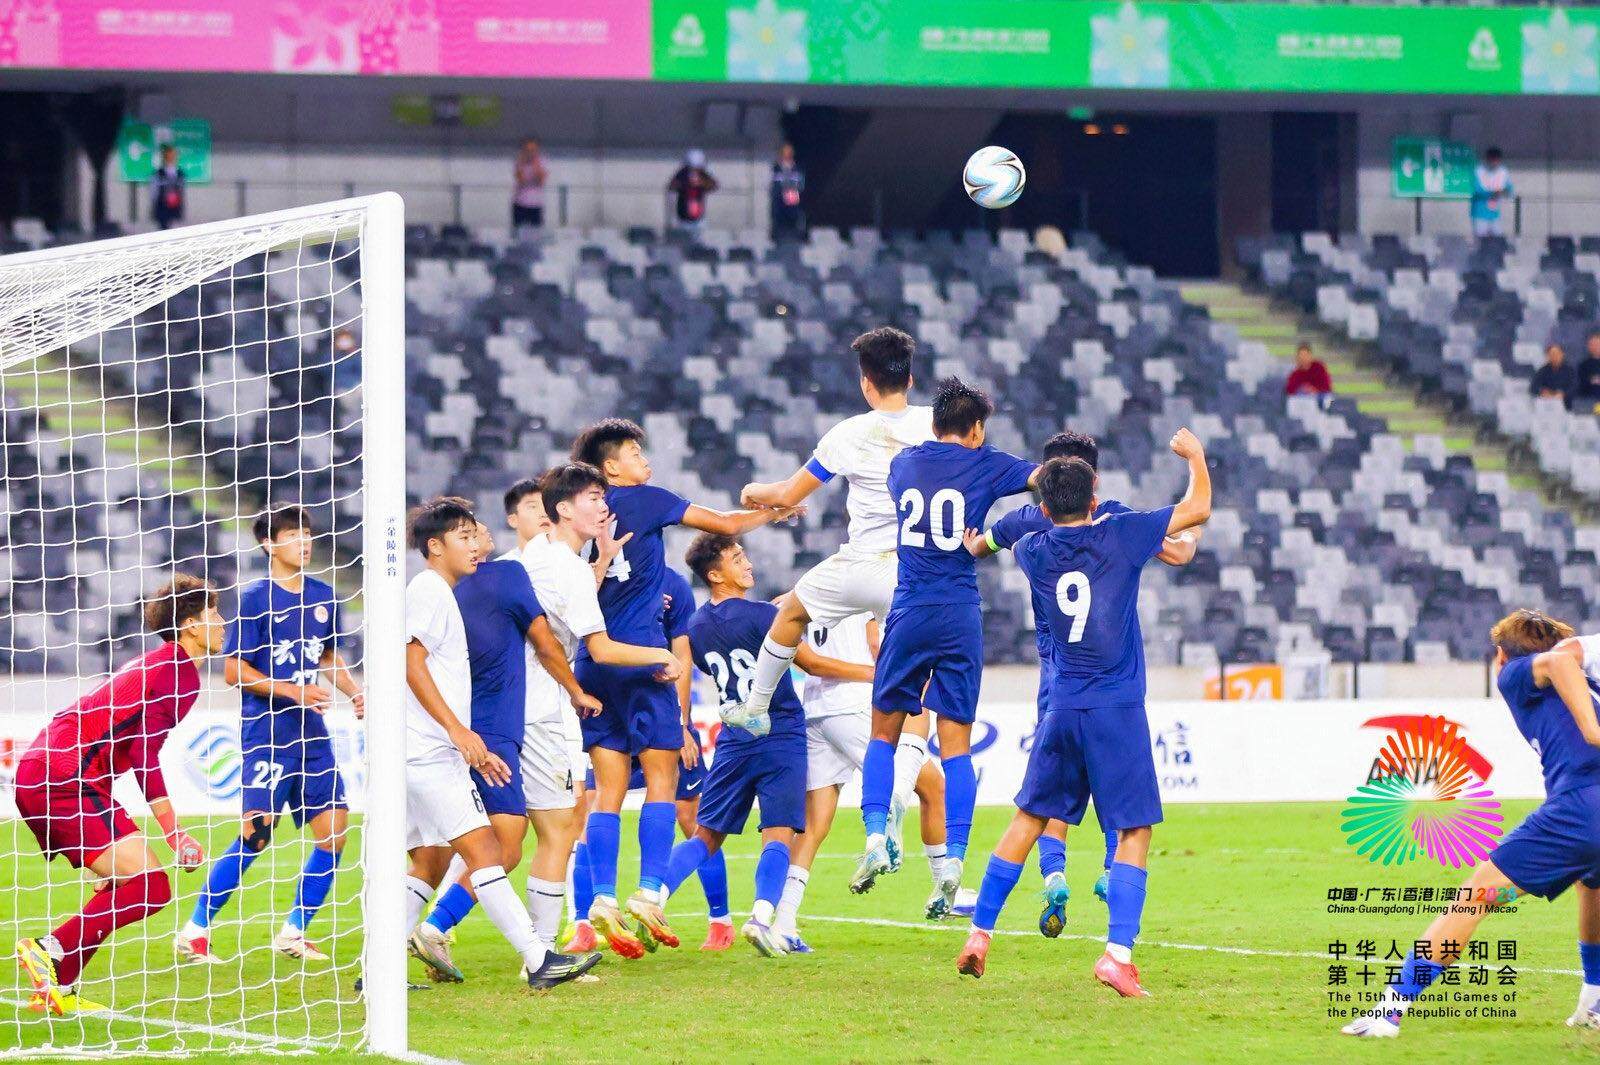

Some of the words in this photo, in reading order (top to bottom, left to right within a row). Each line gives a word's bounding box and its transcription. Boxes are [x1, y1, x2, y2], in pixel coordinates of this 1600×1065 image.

[900, 488, 965, 551] 20
[1055, 570, 1091, 643] 9
[252, 761, 285, 790] 27
[1366, 757, 1440, 786] ANTA
